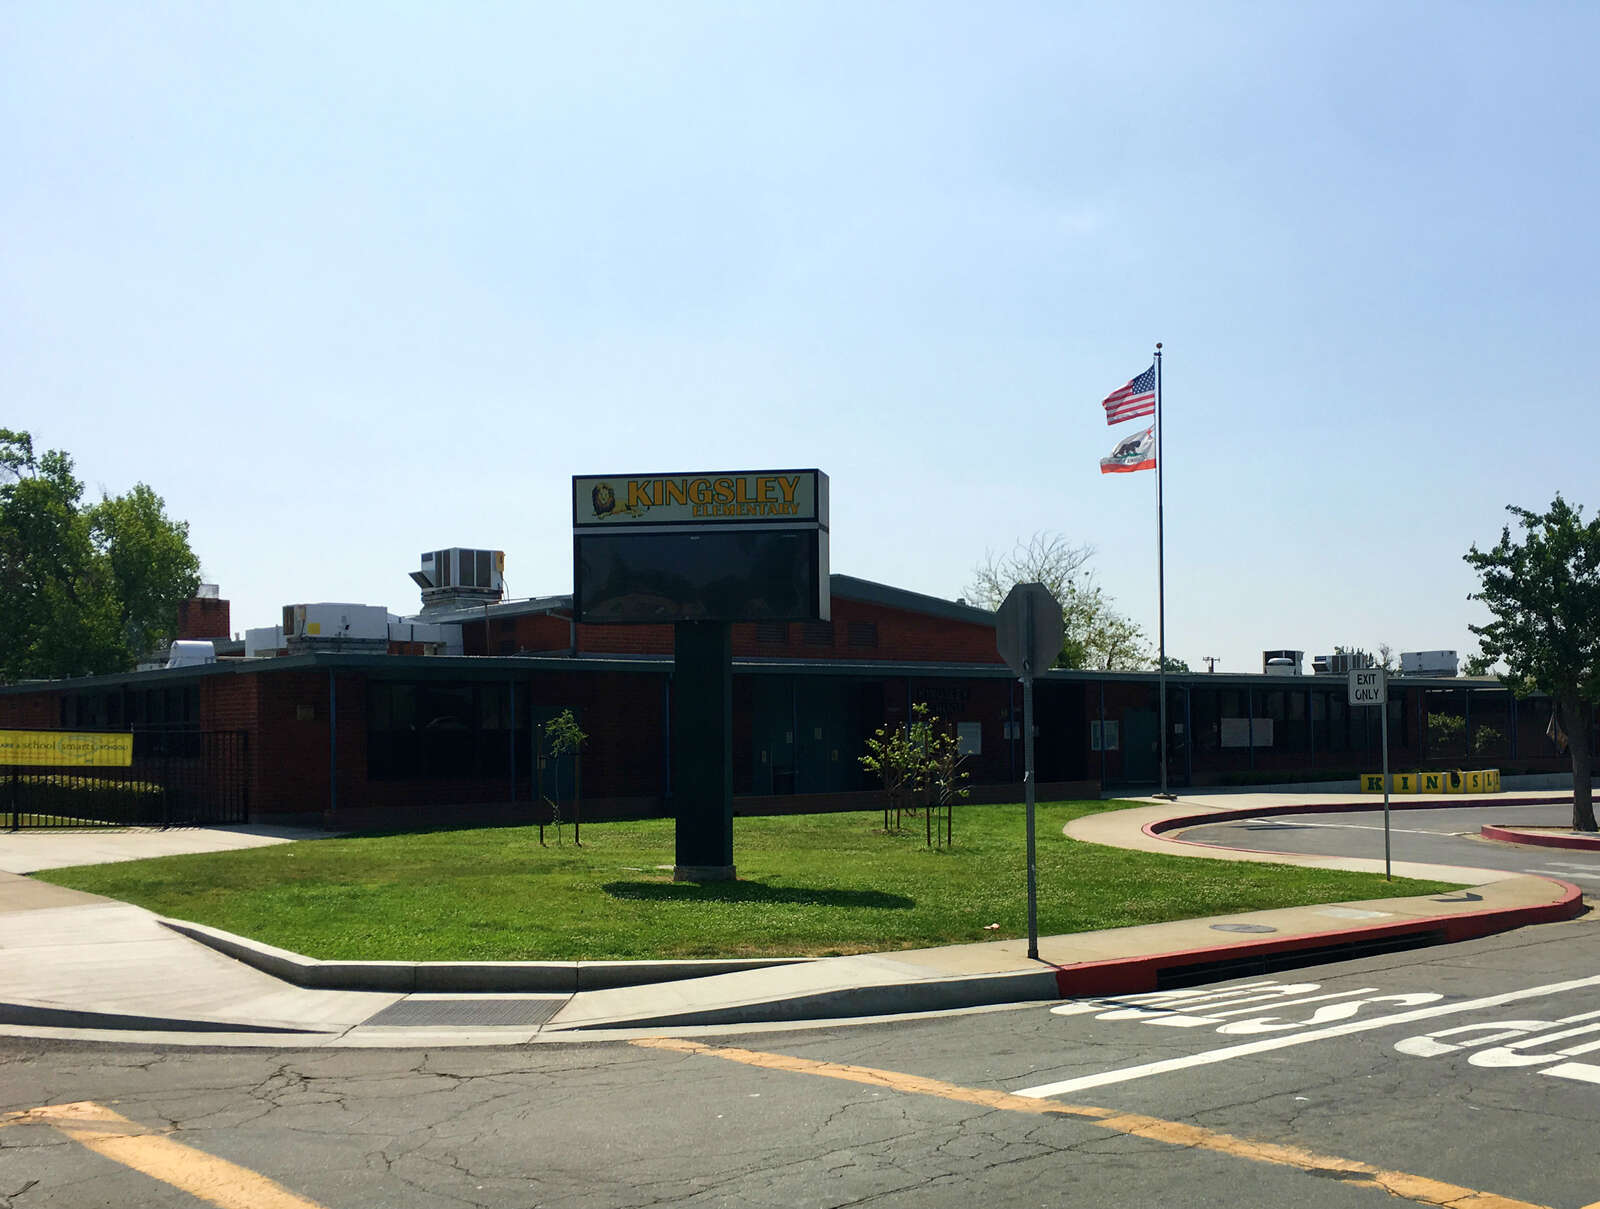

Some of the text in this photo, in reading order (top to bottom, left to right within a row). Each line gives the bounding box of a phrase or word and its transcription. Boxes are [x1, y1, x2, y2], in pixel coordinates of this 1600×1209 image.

[627, 476, 800, 506] KINGSLEY
[692, 502, 800, 517] ELEMENTARY
[1357, 674, 1376, 685] EXIT
[1355, 688, 1379, 700] ONLY
[1049, 980, 1444, 1034] STOP
